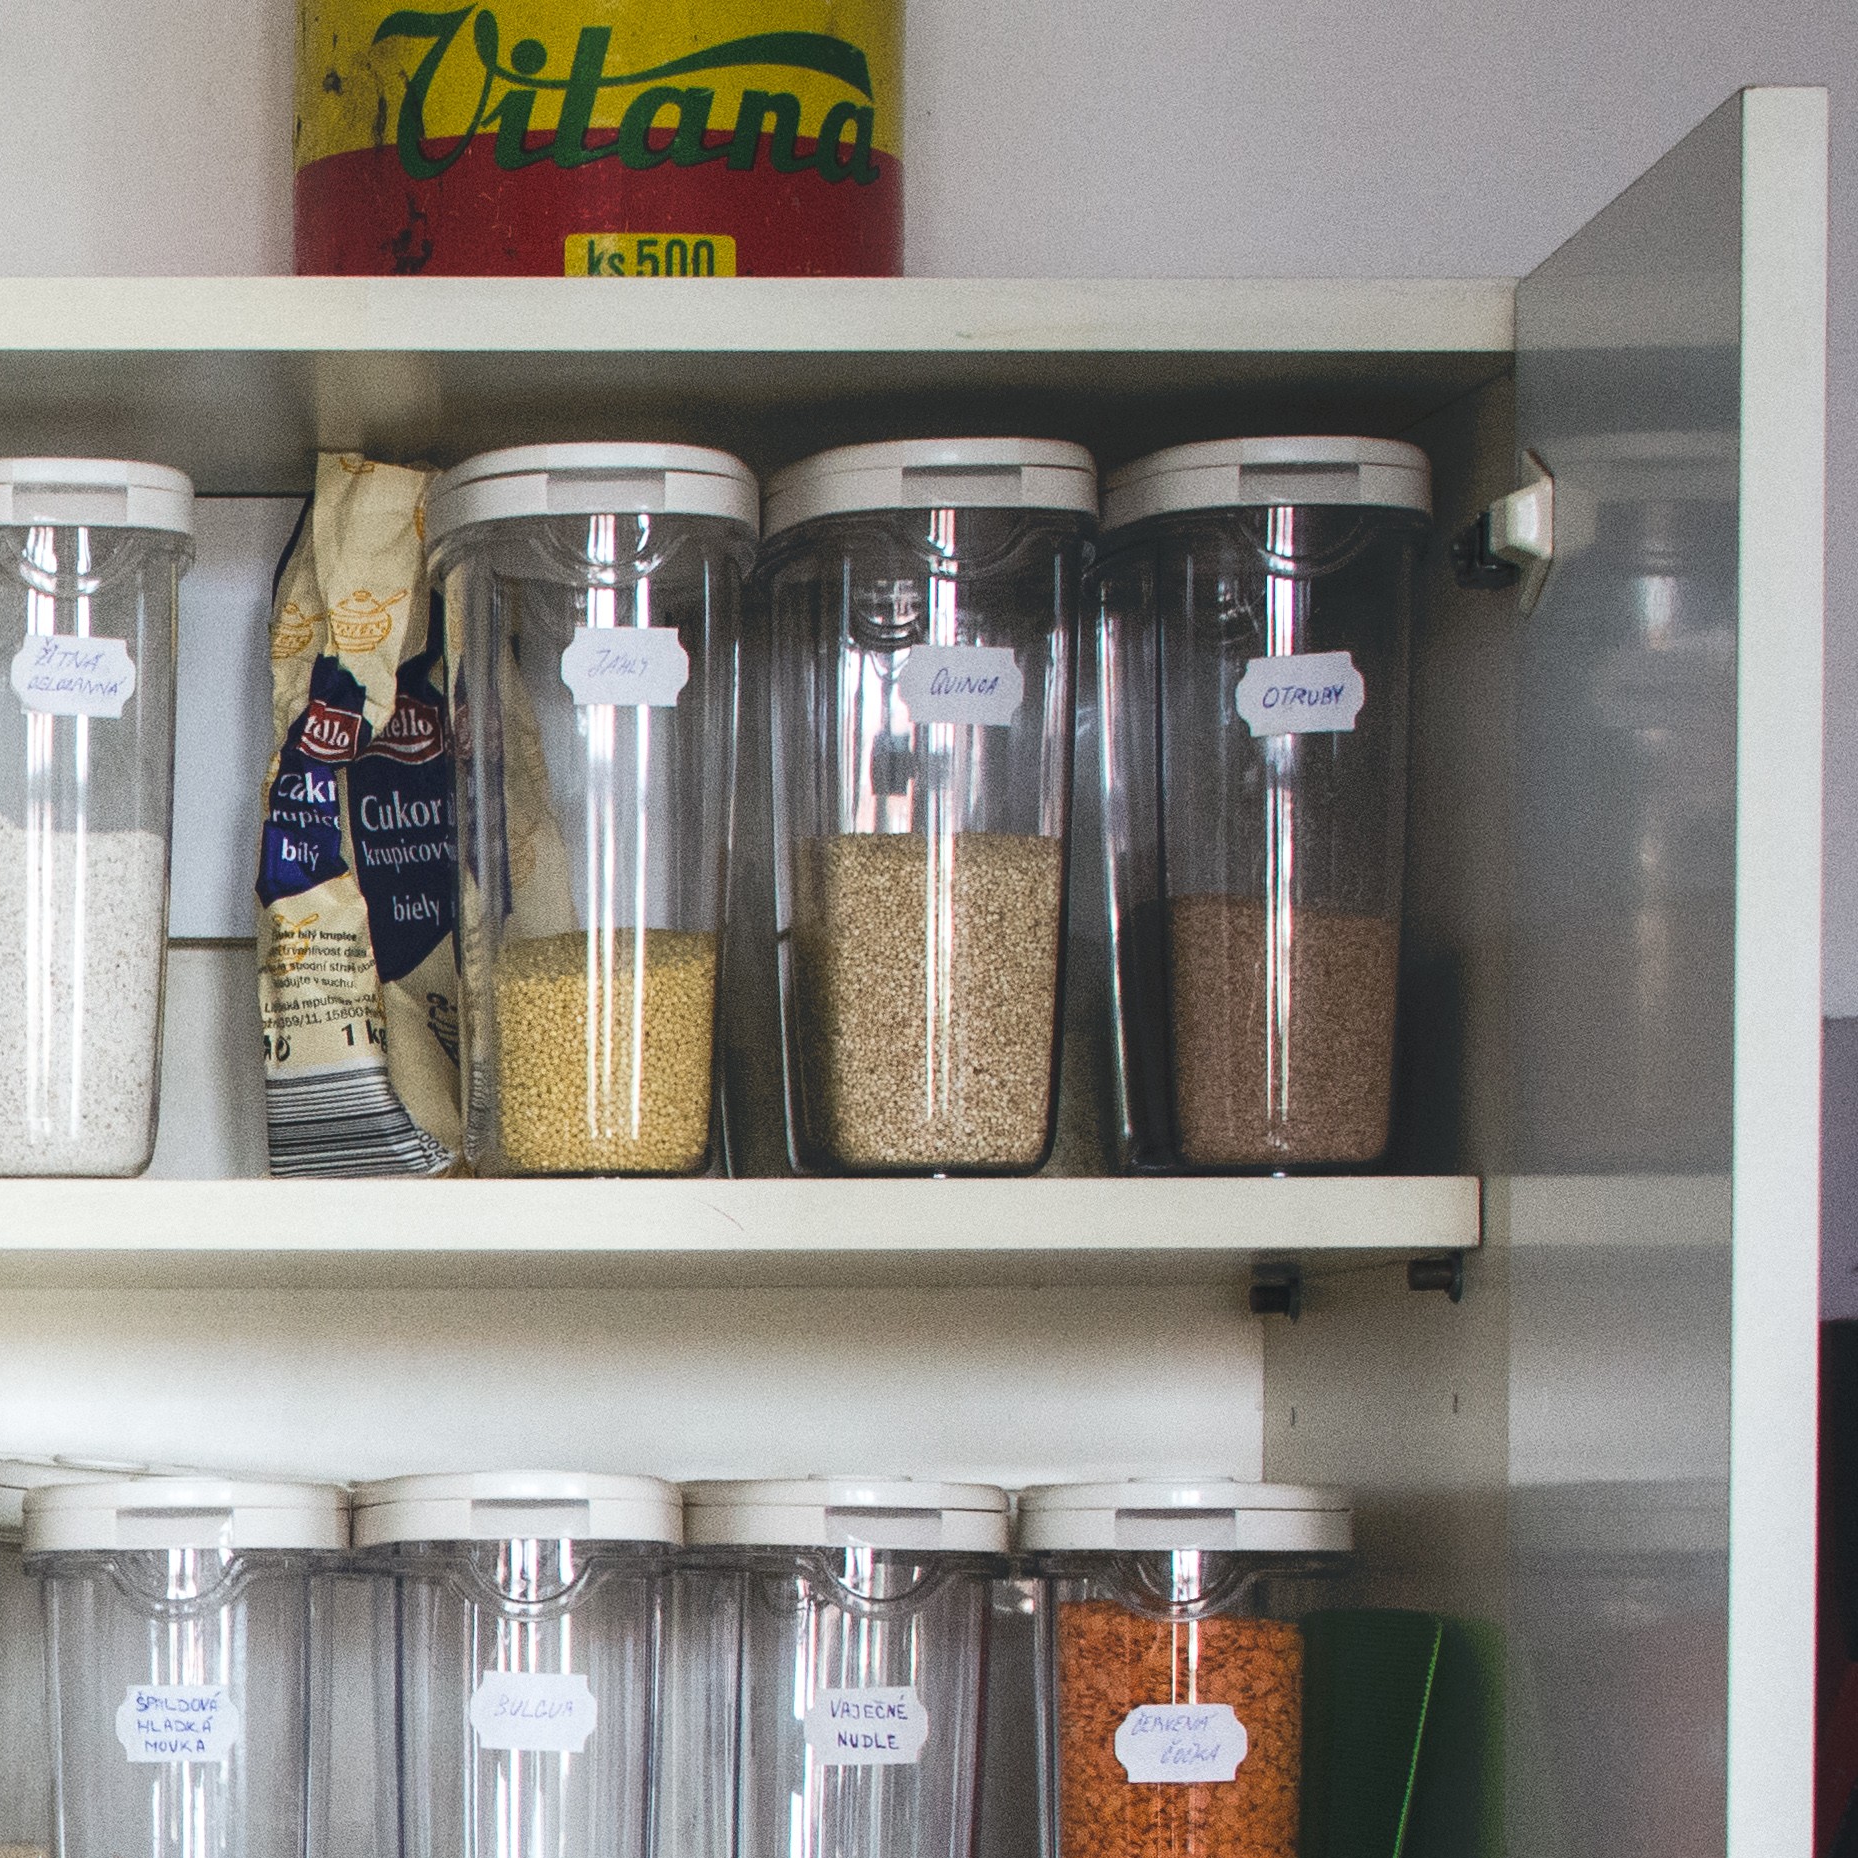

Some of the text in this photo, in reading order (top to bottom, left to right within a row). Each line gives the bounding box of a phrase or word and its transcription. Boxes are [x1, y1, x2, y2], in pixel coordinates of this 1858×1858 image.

[372, 2, 881, 187] Vitana
[587, 238, 715, 277] ks 500
[1262, 683, 1345, 709] OTRUBY
[360, 790, 442, 832] Cukor
[392, 893, 441, 926] biely
[341, 1023, 355, 1047] 1
[830, 1694, 909, 1720] VAJEČNÉ
[136, 1715, 214, 1734] HLADKÁ
[837, 1731, 900, 1750] NUDLE
